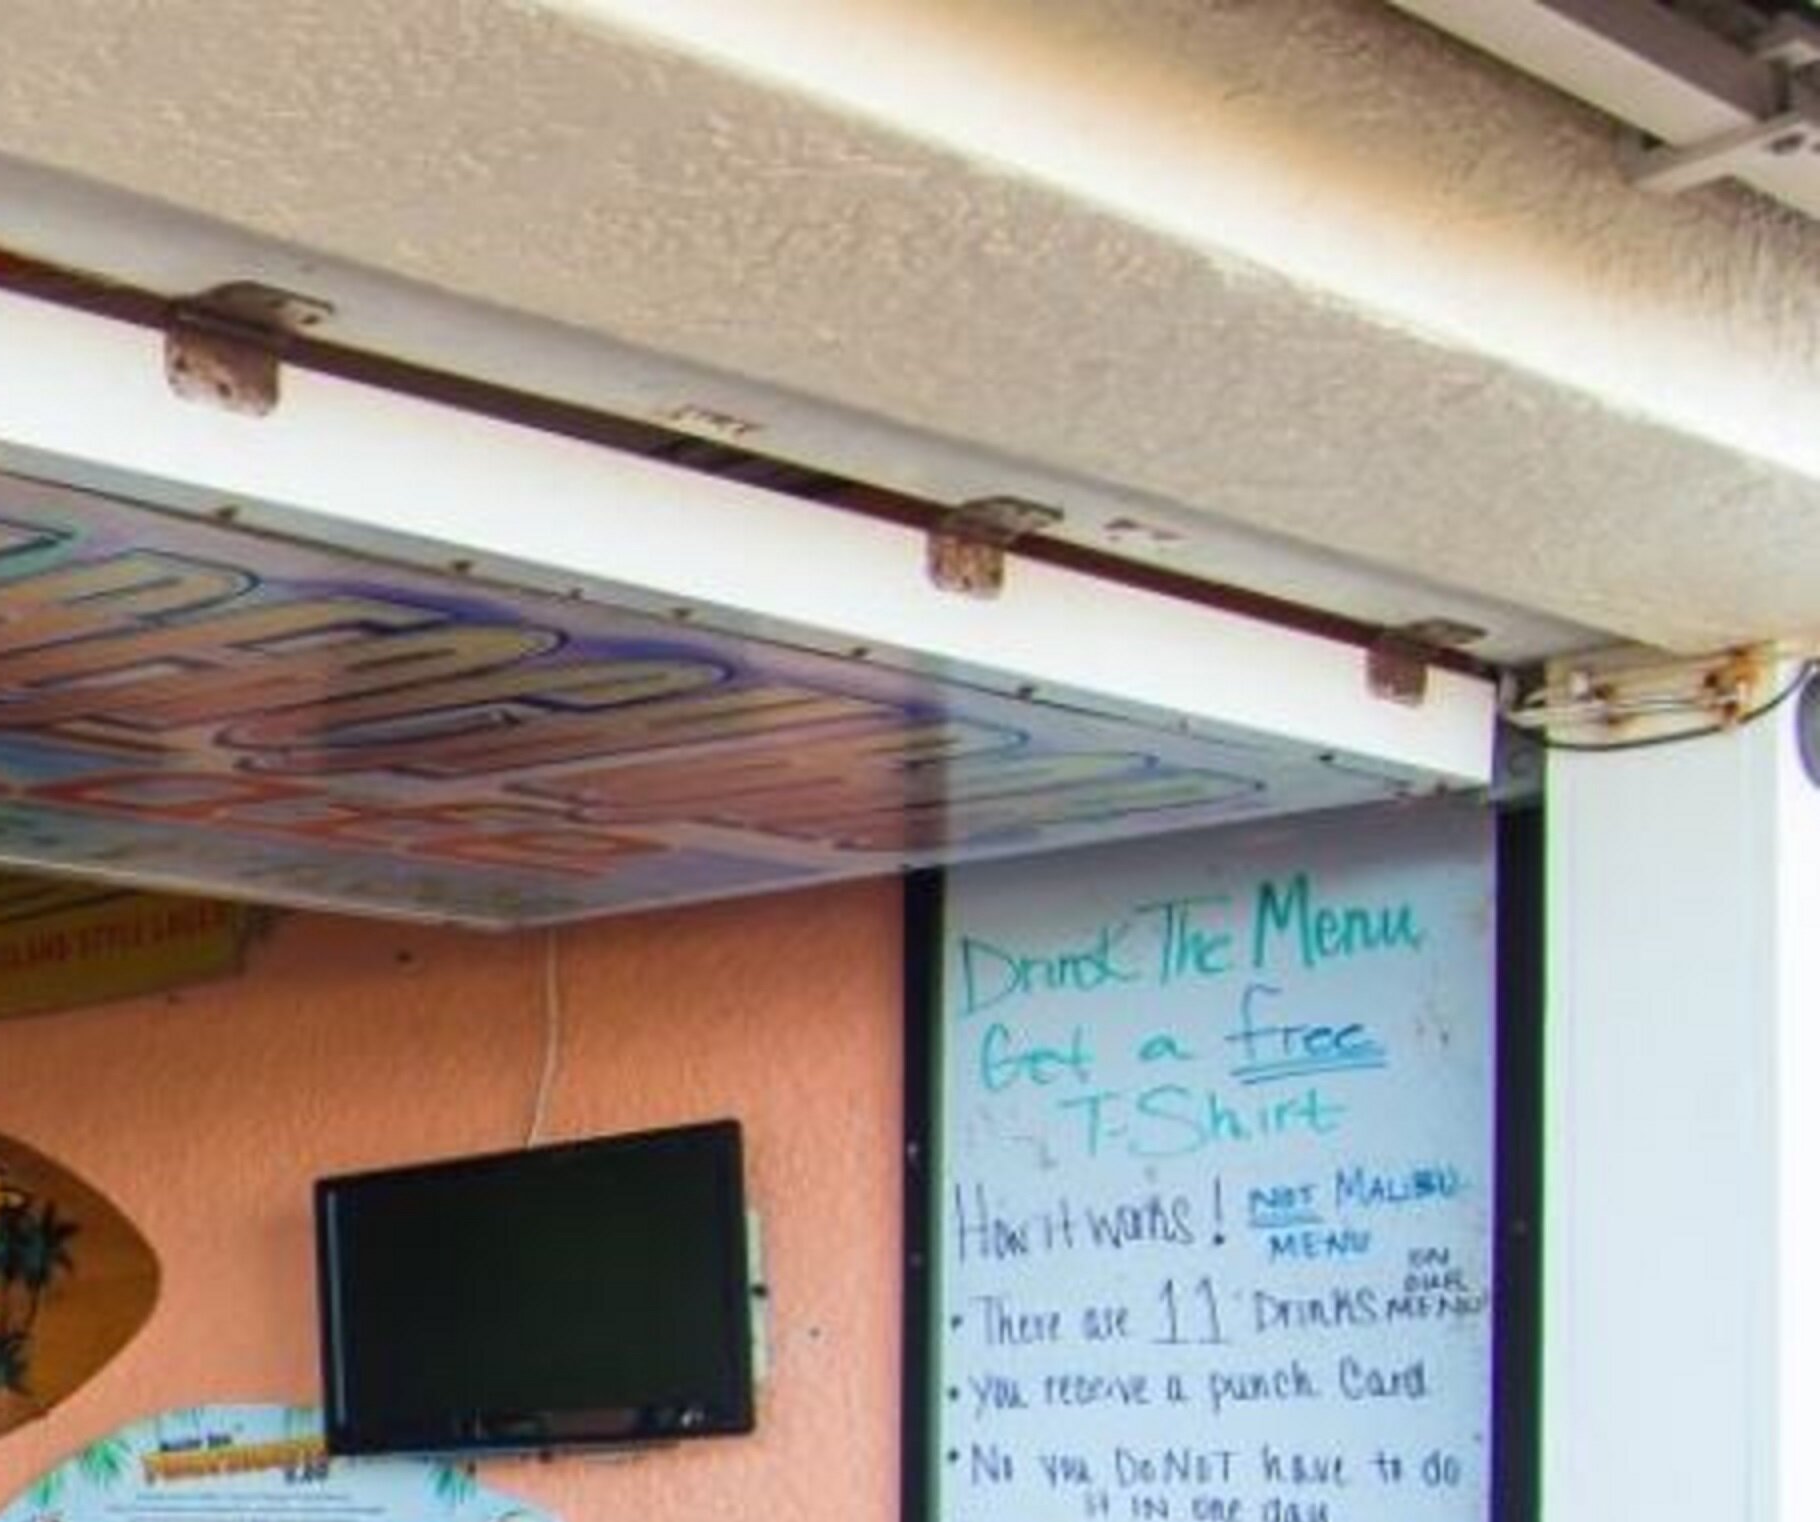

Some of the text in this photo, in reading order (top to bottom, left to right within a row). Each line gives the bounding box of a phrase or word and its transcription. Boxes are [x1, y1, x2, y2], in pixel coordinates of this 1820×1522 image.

[960, 872, 1424, 1014] Drink The Menu
[979, 983, 1380, 1093] Get a free
[956, 1180, 1028, 1262] How
[1247, 1167, 1460, 1220] NOT MALIBU
[1267, 1230, 1372, 1264] MENU
[973, 1296, 1061, 1346] There
[1082, 1306, 1129, 1340] are
[1167, 1374, 1191, 1404] a
[1209, 1361, 1321, 1415] punch
[1337, 1355, 1431, 1402] Card
[1261, 1446, 1346, 1486] have
[1372, 1450, 1405, 1484] to
[1421, 1446, 1462, 1488] do
